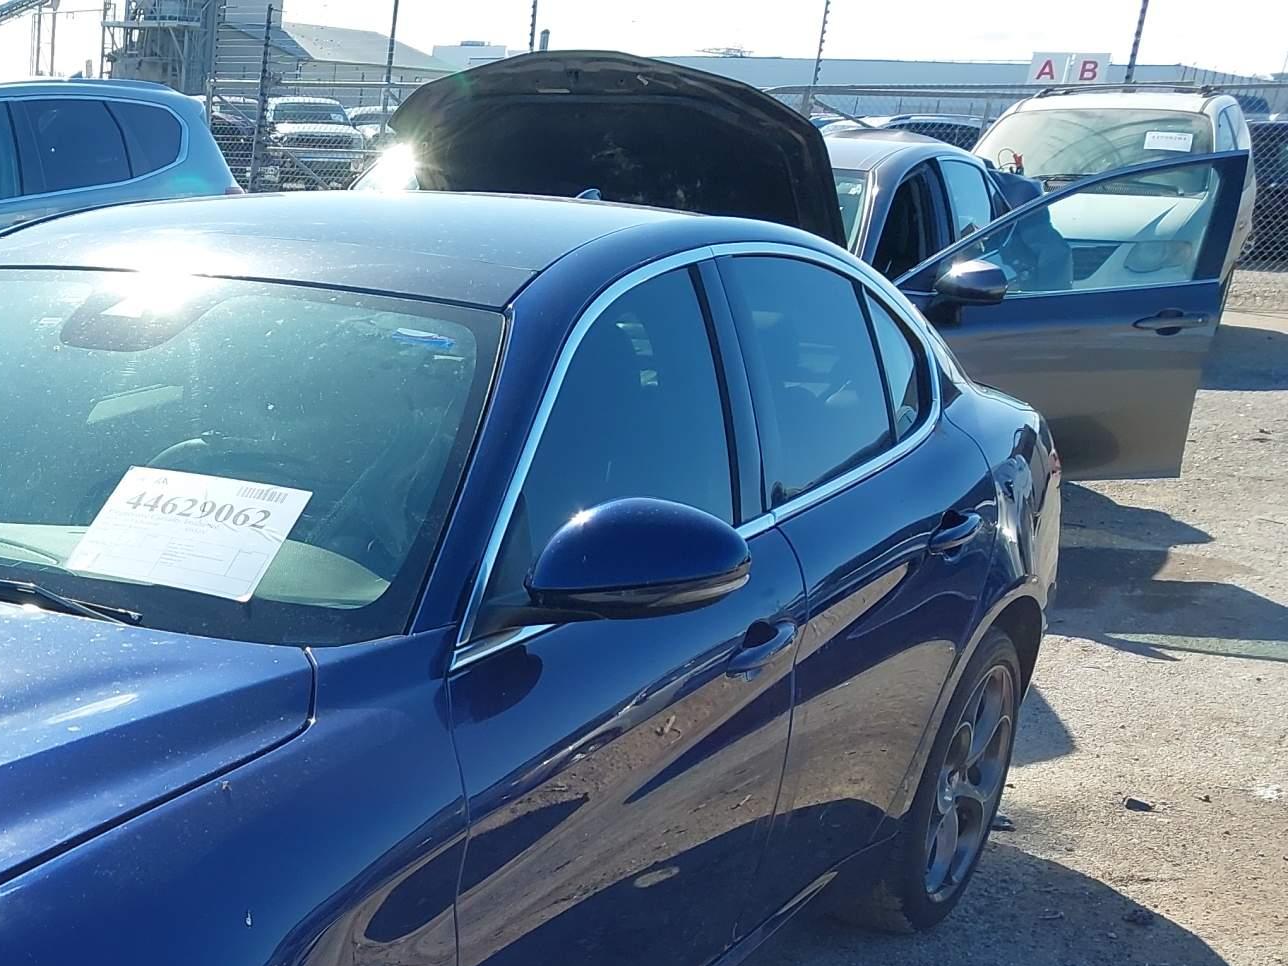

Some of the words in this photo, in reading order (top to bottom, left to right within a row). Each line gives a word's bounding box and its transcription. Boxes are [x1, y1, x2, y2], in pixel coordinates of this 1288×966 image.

[1035, 59, 1055, 80] A
[1078, 60, 1099, 80] B
[125, 490, 272, 530] 44629062
